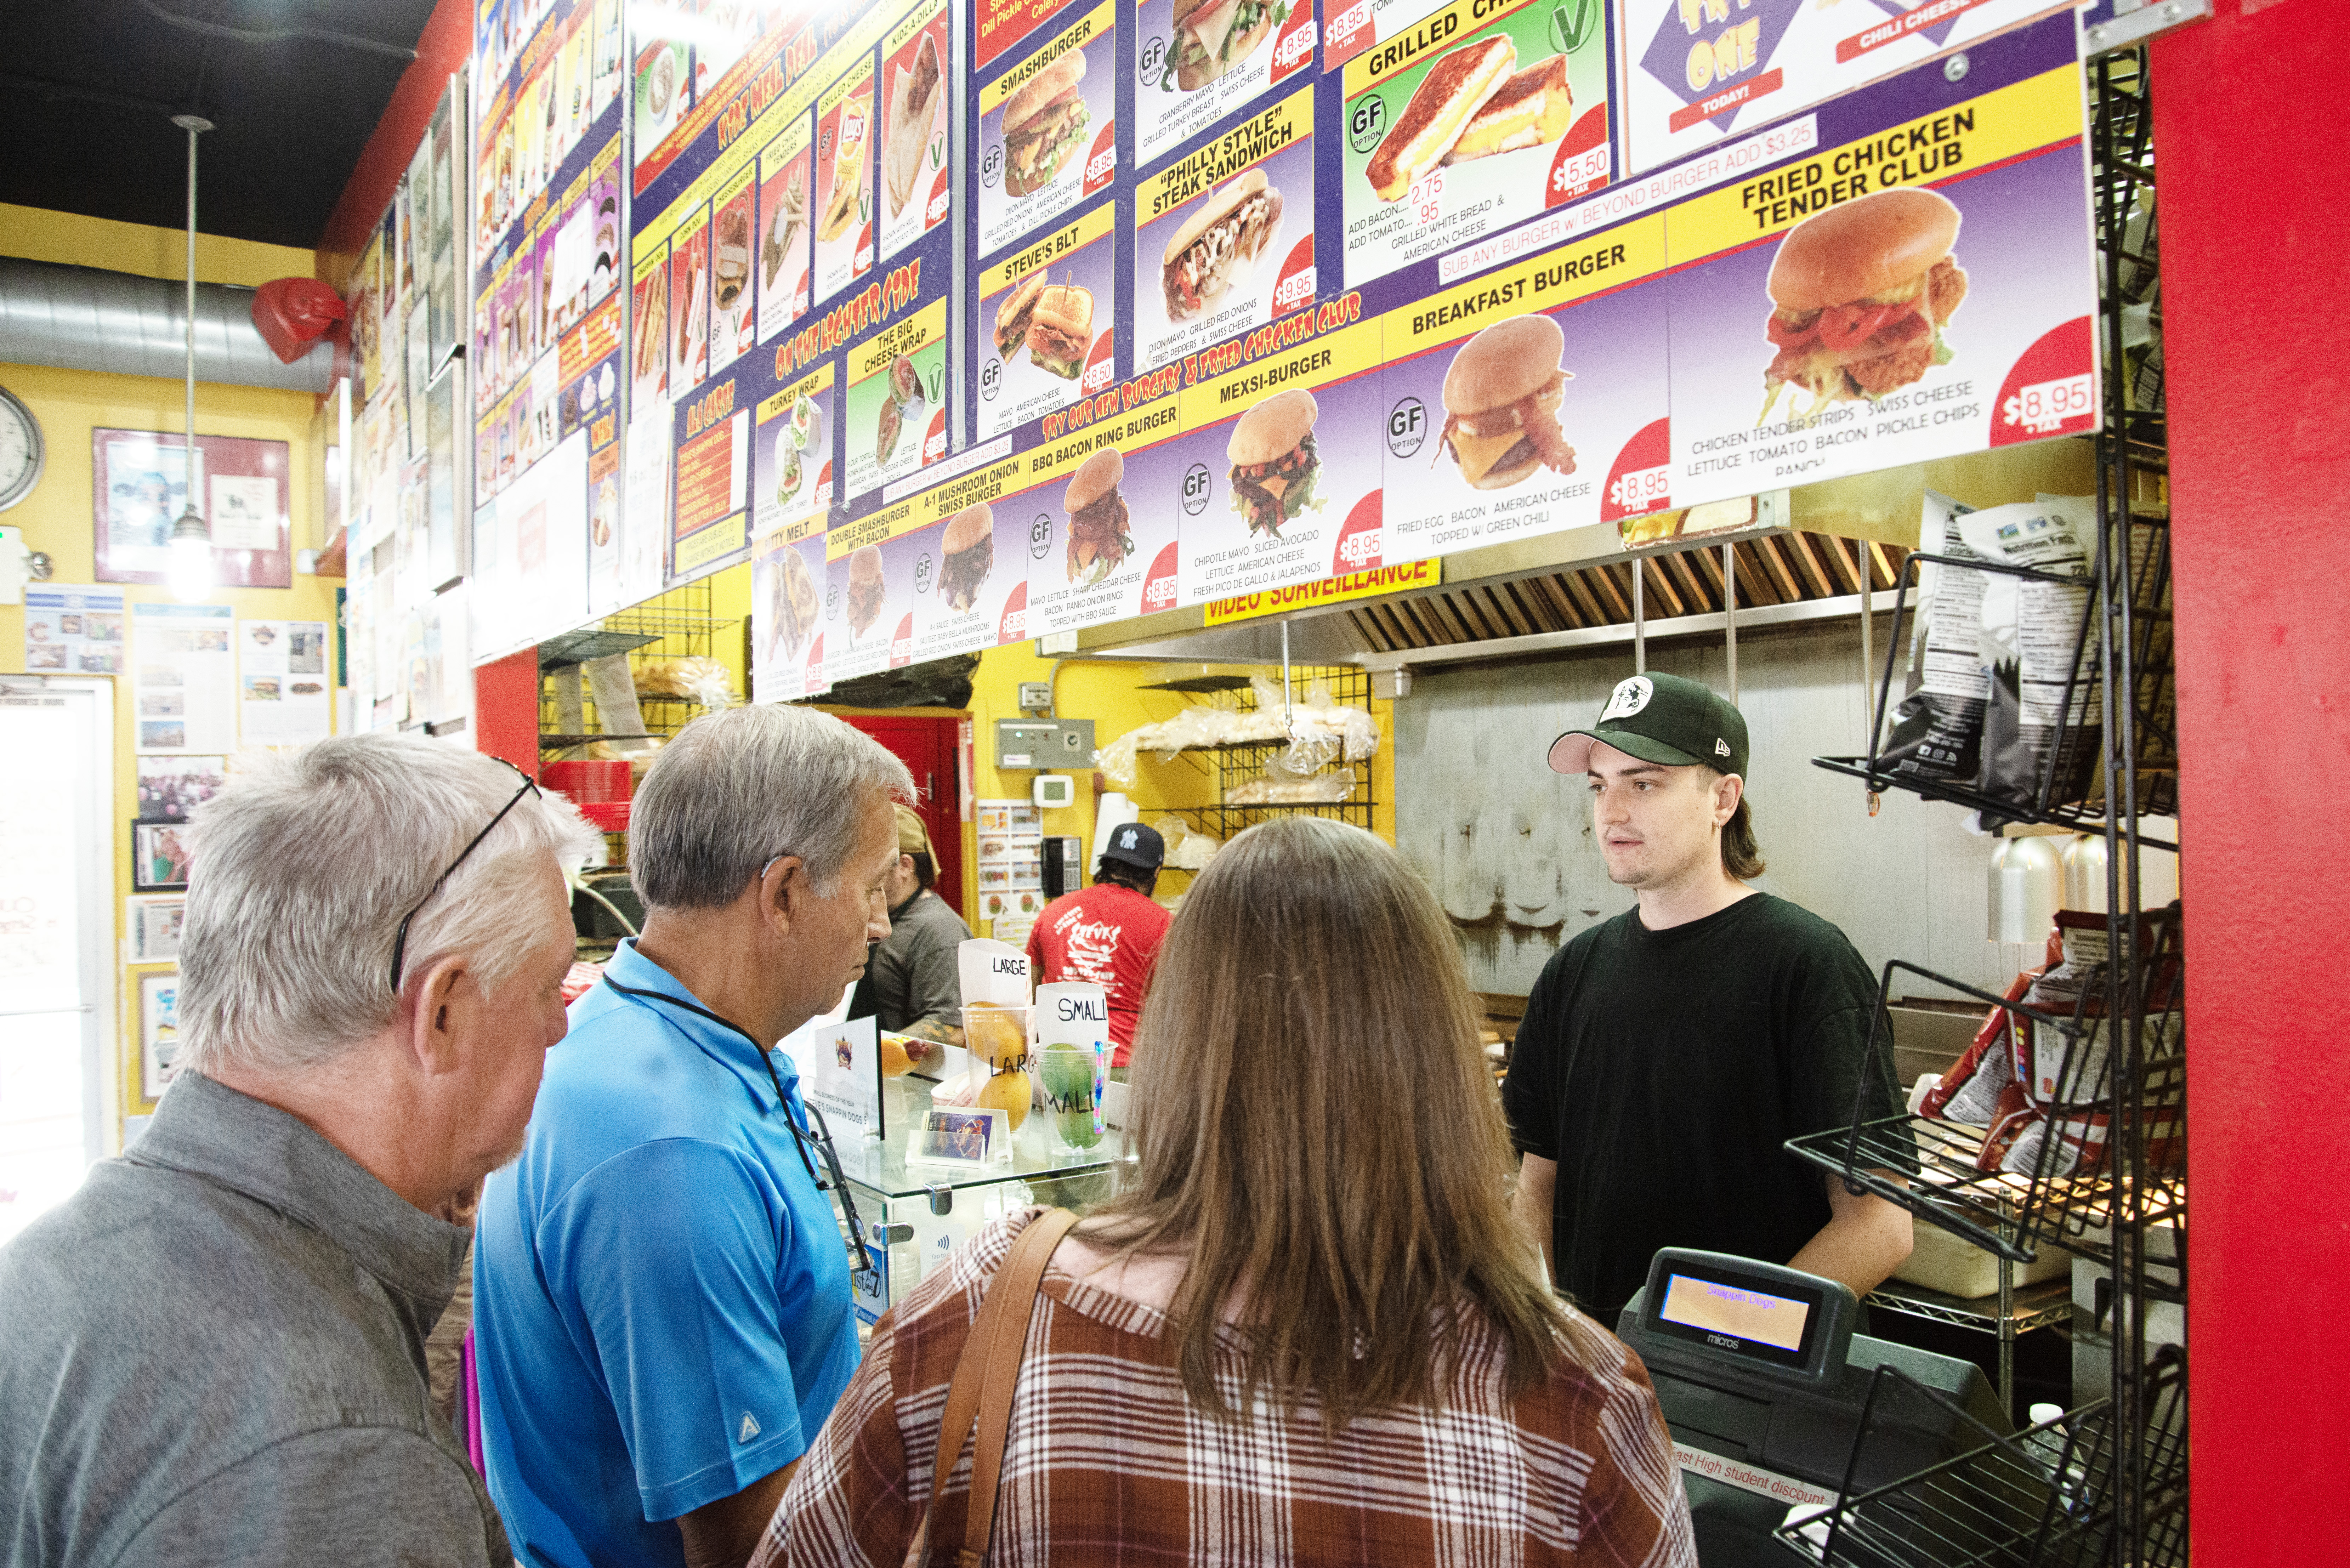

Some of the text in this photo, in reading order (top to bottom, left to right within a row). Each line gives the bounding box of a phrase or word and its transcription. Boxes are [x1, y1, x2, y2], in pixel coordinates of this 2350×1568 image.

[982, 17, 995, 38] Dill
[997, 0, 1022, 26] Pickle
[1860, 20, 1902, 47] CHILI
[1001, 19, 1091, 97] SMASHBURGER
[1275, 25, 1312, 67] $8.95
[1369, 11, 1458, 76] GRILLED
[1686, 16, 1759, 91] ONE
[847, 57, 872, 87] CHEESE
[1159, 62, 1245, 124] CRANBERRY MAYO LETTUCE
[1702, 86, 1750, 114] TODAY!
[1353, 101, 1381, 134] GF
[1153, 121, 1293, 215] STEAK SANDWICH
[1554, 151, 1607, 192] $5.50
[1742, 108, 1975, 209] FRIED CHICKEN
[1444, 255, 1469, 275] SUB
[1473, 245, 1497, 265] ANY
[1502, 220, 1560, 255] BURGER
[1583, 185, 1646, 226] BEYOND
[1650, 160, 1719, 199] BURGER
[1725, 143, 1761, 174] ADD
[1766, 123, 1811, 156] $3.25
[1754, 141, 1963, 229] TENDER CLUB
[1348, 174, 1442, 235] ADD 2.75
[1056, 226, 1079, 253] BLT
[1349, 235, 1366, 250] ADD
[1275, 275, 1311, 306] $9.95
[1413, 244, 1625, 335] BREAKFAST BURGER
[775, 338, 794, 380] ON
[795, 321, 820, 369] THE
[882, 257, 920, 320] SIDE
[878, 319, 913, 349] THE BIG
[864, 328, 926, 376] CHEESE WRAP
[1042, 410, 1066, 442] TRY
[1068, 399, 1094, 430] OUR
[1095, 388, 1119, 420] NEW
[1122, 363, 1182, 411] BURGERS
[1199, 343, 1242, 379] FRIED
[1244, 308, 1314, 363] CHICKEN
[1318, 293, 1359, 331] CLUB
[770, 375, 819, 413] TURKEY WRAP
[1084, 365, 1110, 387] $8.50
[1220, 350, 1332, 403] MEXSI-BURGER
[1390, 406, 1421, 436] GF
[1692, 380, 1972, 455] CHICKEN TENDER STRIPS SWISS CHEESE
[2004, 382, 2087, 425] $8.95
[1033, 406, 1176, 472] BBQ BACON RING BURGER
[1391, 436, 1421, 451] OPTION
[1688, 403, 1980, 477] LETTUCE TOMATO BACON PICKLE CHIPS
[924, 460, 1019, 509] A-1 MUSHROOM ONION
[938, 482, 1001, 517] SWISS BURGER
[787, 521, 810, 540] MELT
[831, 505, 910, 546] DOUBLE SMASHBURGER
[848, 526, 889, 551] WITH BACON
[1194, 529, 1319, 567] CHIPOTLE MAYO SLICED AVOCADO
[1031, 572, 1141, 606] MAYO LETTUCE SHARP CHEDDAR CHEESE
[1146, 579, 1175, 602] $8.95
[1193, 561, 1321, 597] FRESH PICO DE GALLO & JALAPENOS
[920, 621, 990, 644] SAUTEED BABY BELLA MUSHROOMS
[936, 612, 979, 629] SAUCE SWISS CHEESE
[1050, 606, 1116, 627] TOPPED WITH BBQ SAUCE
[993, 957, 1026, 975] LARGE
[826, 1105, 862, 1125] SNAPPIN DOGS
[1707, 1285, 1776, 1309] Snappin Dogs
[1707, 1333, 1739, 1350] micros
[1673, 1447, 1825, 1504] ast High student discount
